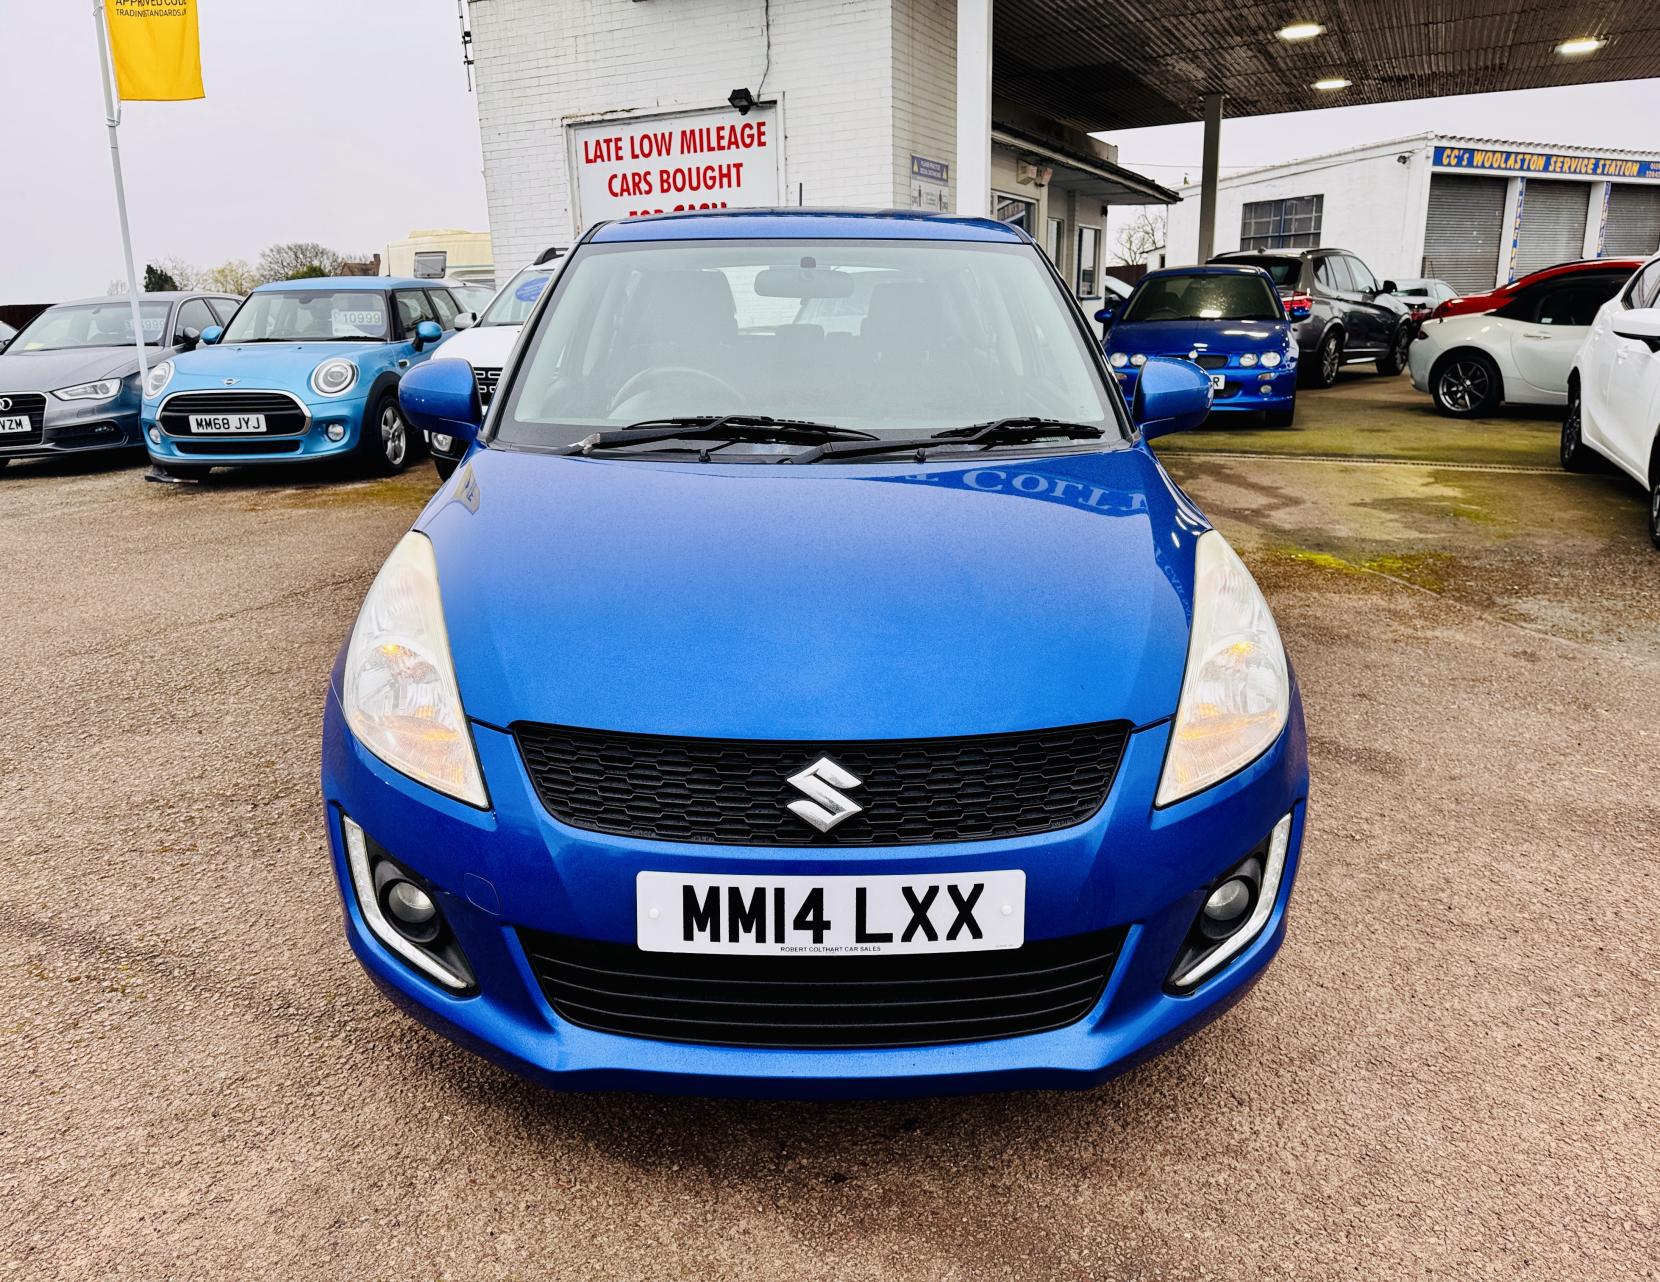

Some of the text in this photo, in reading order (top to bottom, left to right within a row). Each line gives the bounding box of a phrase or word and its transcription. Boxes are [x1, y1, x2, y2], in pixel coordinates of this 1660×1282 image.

[584, 122, 767, 164] LATE LOW MILEAGE
[1473, 151, 1545, 171] WOOLASTON
[1549, 156, 1594, 174] SERVICE
[1597, 160, 1640, 177] STATION
[608, 163, 743, 198] CARS BOUGHT
[343, 312, 381, 324] 10999
[195, 417, 261, 430] MM68 JYJ
[682, 883, 985, 944] MM14 LXX
